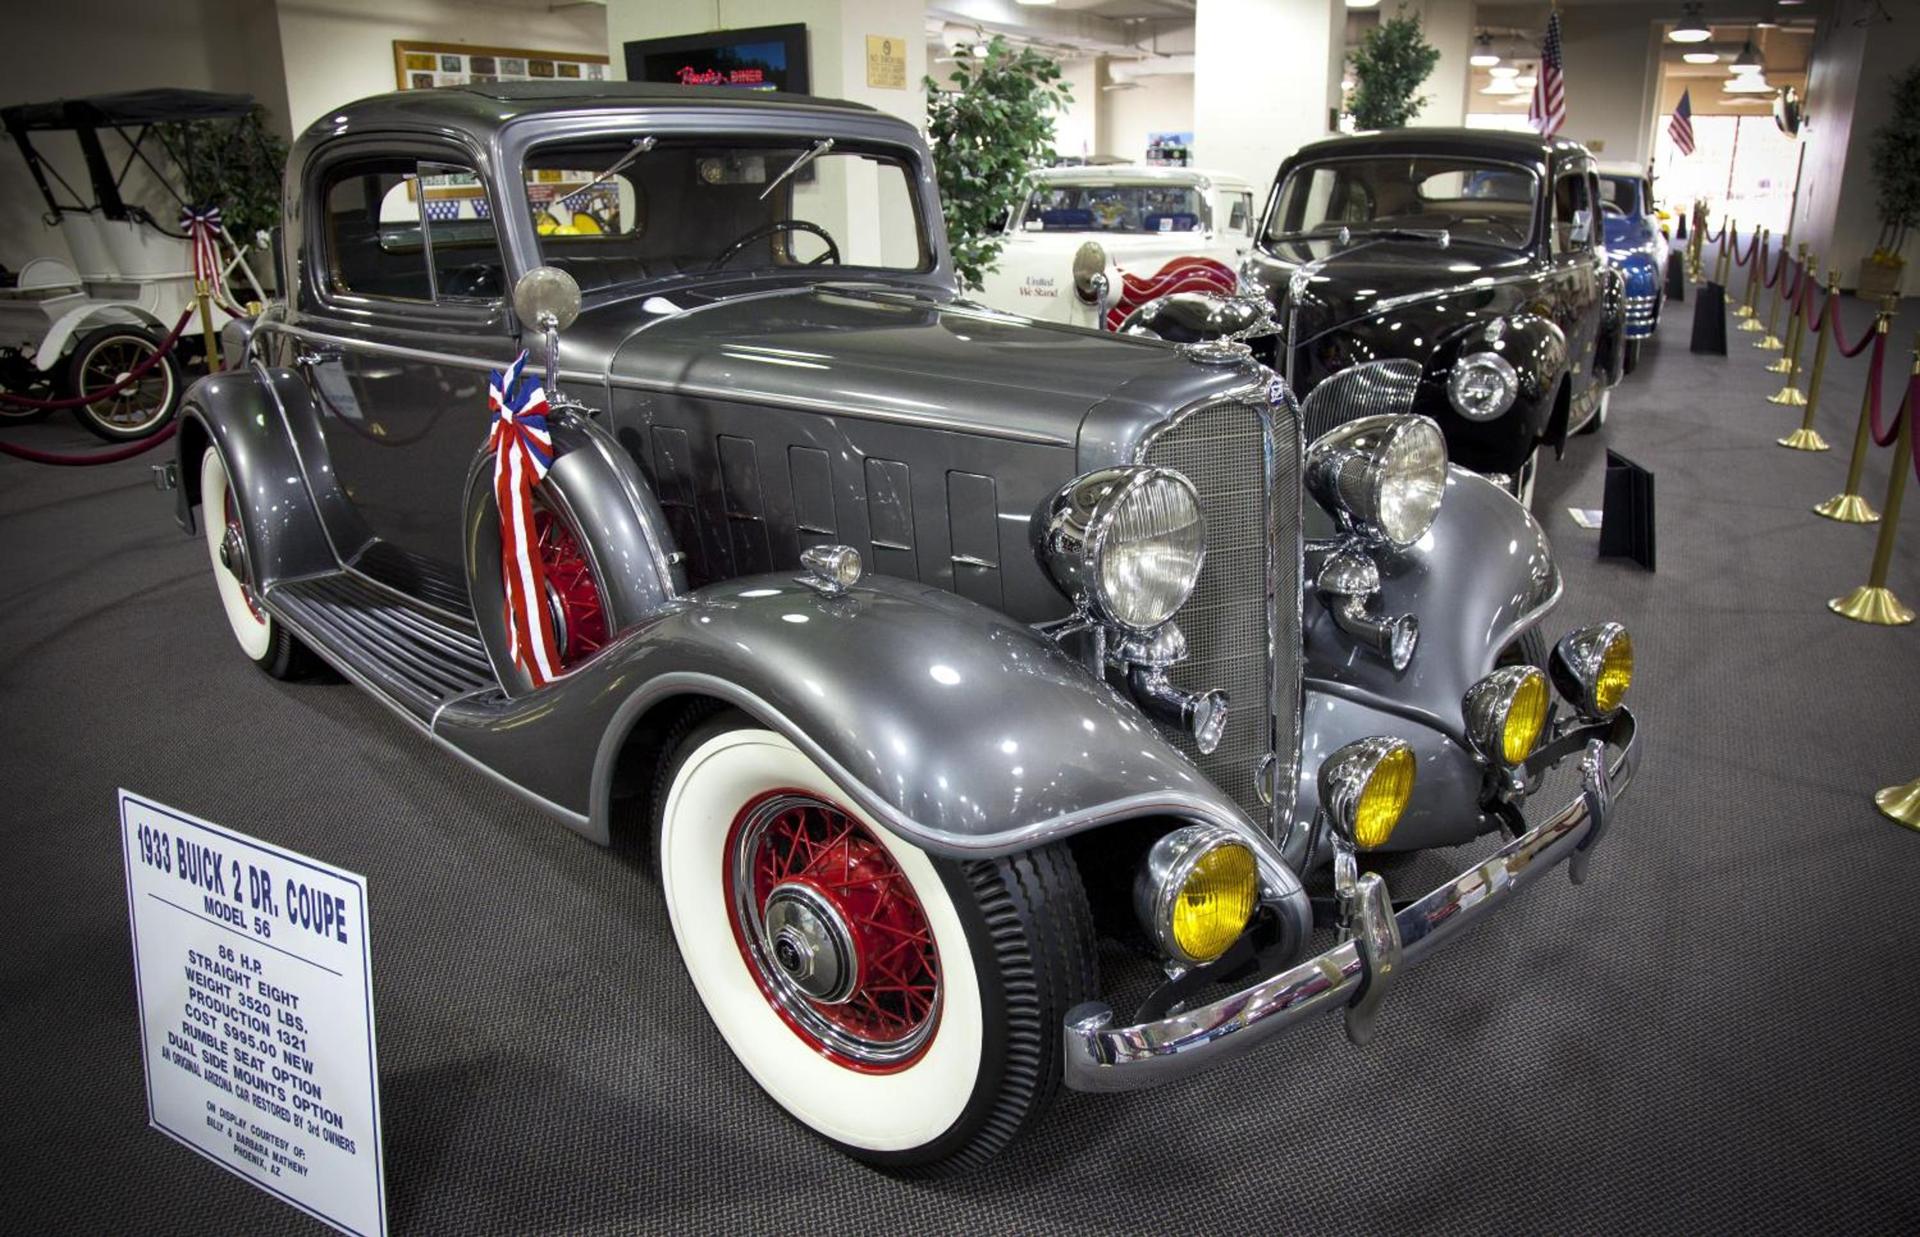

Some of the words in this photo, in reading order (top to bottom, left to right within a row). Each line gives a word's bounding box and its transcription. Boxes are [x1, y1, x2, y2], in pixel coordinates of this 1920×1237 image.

[1019, 286, 1032, 297] We
[1034, 287, 1058, 298] Stand
[1026, 276, 1054, 286] United
[138, 823, 171, 873] 1933
[176, 837, 226, 896] BUICK
[232, 860, 243, 903] 2
[249, 865, 279, 918] DR.
[286, 879, 348, 944] COUPE
[204, 896, 247, 930] MODEL
[254, 917, 271, 938] 56
[188, 949, 251, 989] STRAIGHT
[258, 981, 299, 1009] EIGHT
[218, 944, 234, 963] 86
[240, 953, 263, 975] H.P.
[185, 966, 231, 999] WEIGHT
[238, 992, 271, 1017] 3520
[278, 1008, 308, 1034] LBS.
[189, 986, 270, 1037] PRODUCTION
[276, 1029, 306, 1053] 1321
[182, 1021, 228, 1056] RUMBLE
[234, 1047, 265, 1073] SEAT
[272, 1066, 322, 1100] OPTION
[185, 1004, 217, 1029] COST
[224, 1022, 276, 1058] $995.00
[283, 1049, 314, 1075] NEW
[162, 1046, 171, 1062] AN
[172, 1051, 202, 1078] ORIGINAL
[204, 1069, 232, 1093] ARIZONA
[235, 1084, 250, 1101] CAR
[252, 1093, 291, 1123] RESTORED
[293, 1113, 303, 1129] BY
[307, 1120, 320, 1137] 3rd
[323, 1127, 356, 1155] OWNERS
[168, 1031, 197, 1057] DUAL
[202, 1049, 228, 1073] SIDE
[233, 1065, 286, 1102] MOUNTS
[293, 1095, 343, 1129] OPTION
[206, 1100, 216, 1112] ON
[219, 1106, 247, 1129] DISPLAY
[250, 1120, 290, 1151] COURTESY
[206, 1116, 224, 1133] BILLY
[227, 1127, 233, 1138] &
[236, 1132, 269, 1158] BARBARA
[272, 1148, 308, 1177] MATHENY
[233, 1144, 267, 1172] PHOENIX,
[270, 1162, 281, 1177] AZ
